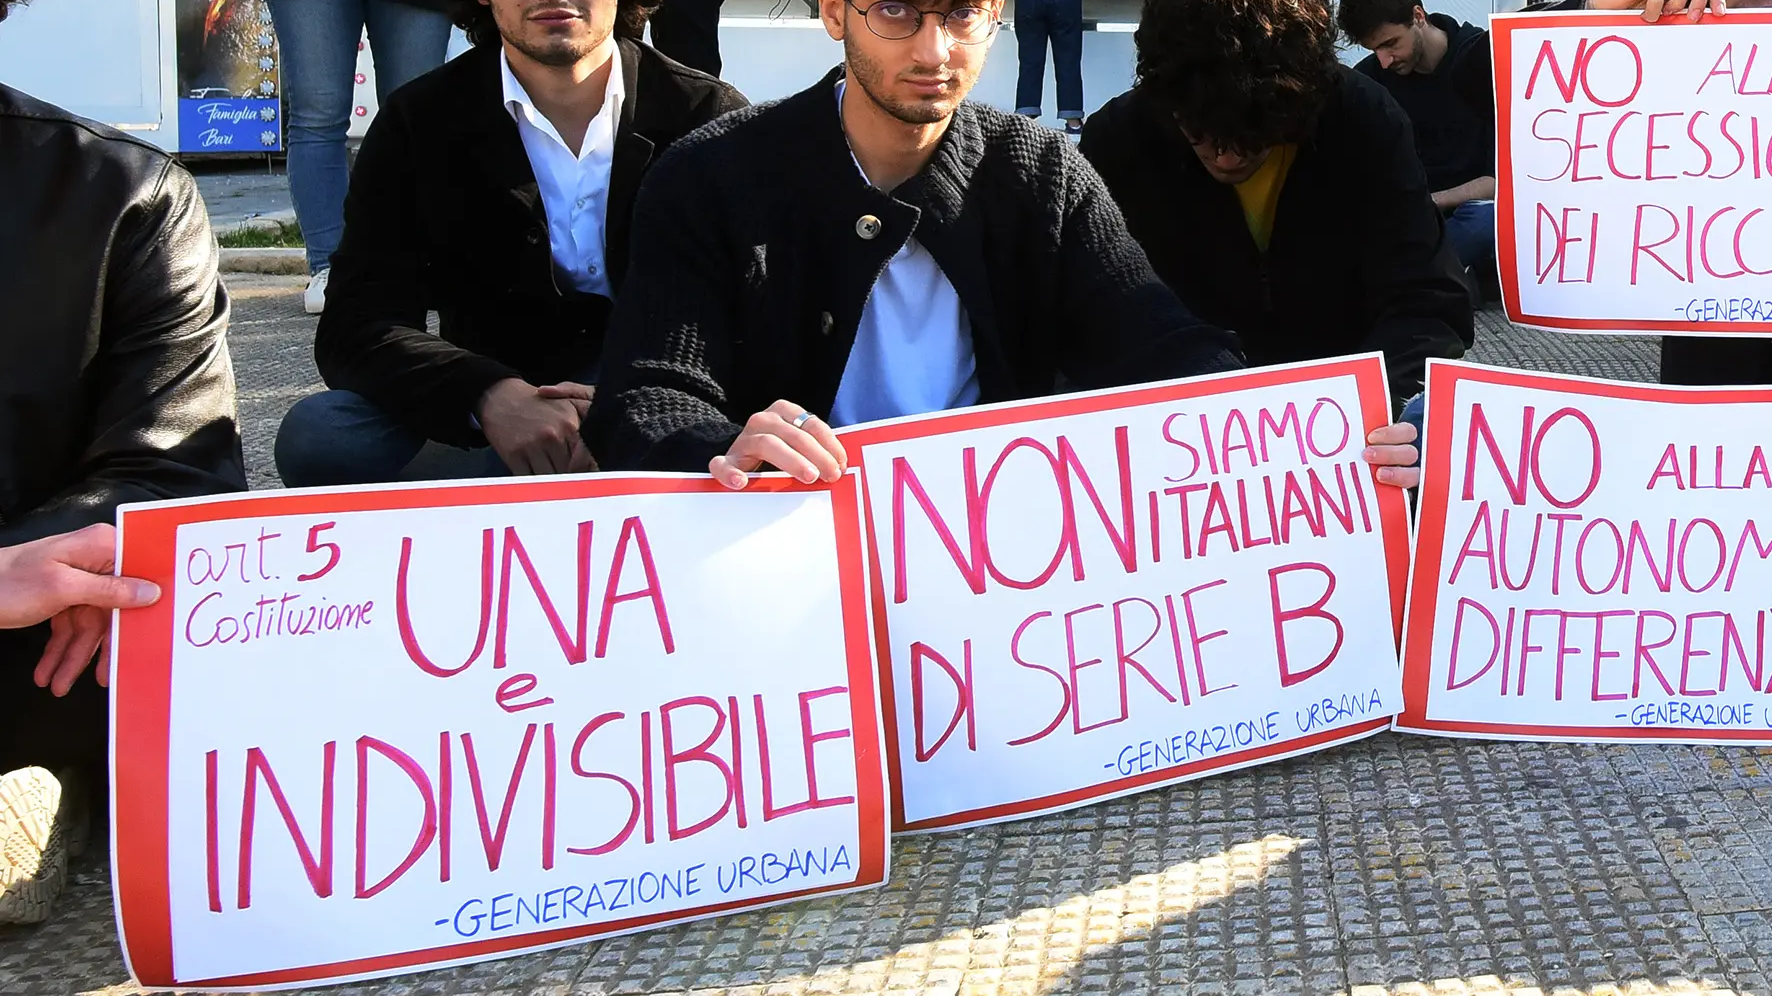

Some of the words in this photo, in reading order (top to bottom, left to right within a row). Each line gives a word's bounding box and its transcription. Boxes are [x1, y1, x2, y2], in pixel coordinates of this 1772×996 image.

[1525, 35, 1643, 108] NO
[197, 102, 258, 124] Famiglia
[198, 128, 233, 147] Bari
[1536, 203, 1599, 285] DEI
[1162, 397, 1350, 482] SIAMO
[1462, 403, 1602, 509] NO
[1646, 443, 1772, 490] ALLA
[893, 426, 1138, 604] NON
[1149, 461, 1372, 562] ITALIANI
[186, 526, 283, 586] art.
[297, 520, 342, 583] 5
[397, 516, 675, 678] UNA
[495, 673, 554, 713] e
[910, 639, 976, 762] DI
[1006, 579, 1238, 745] SERIE
[1268, 561, 1344, 688] B
[1296, 688, 1383, 734] URBANA
[206, 686, 855, 912] INDIVISIBILE
[717, 844, 851, 897] URBANA
